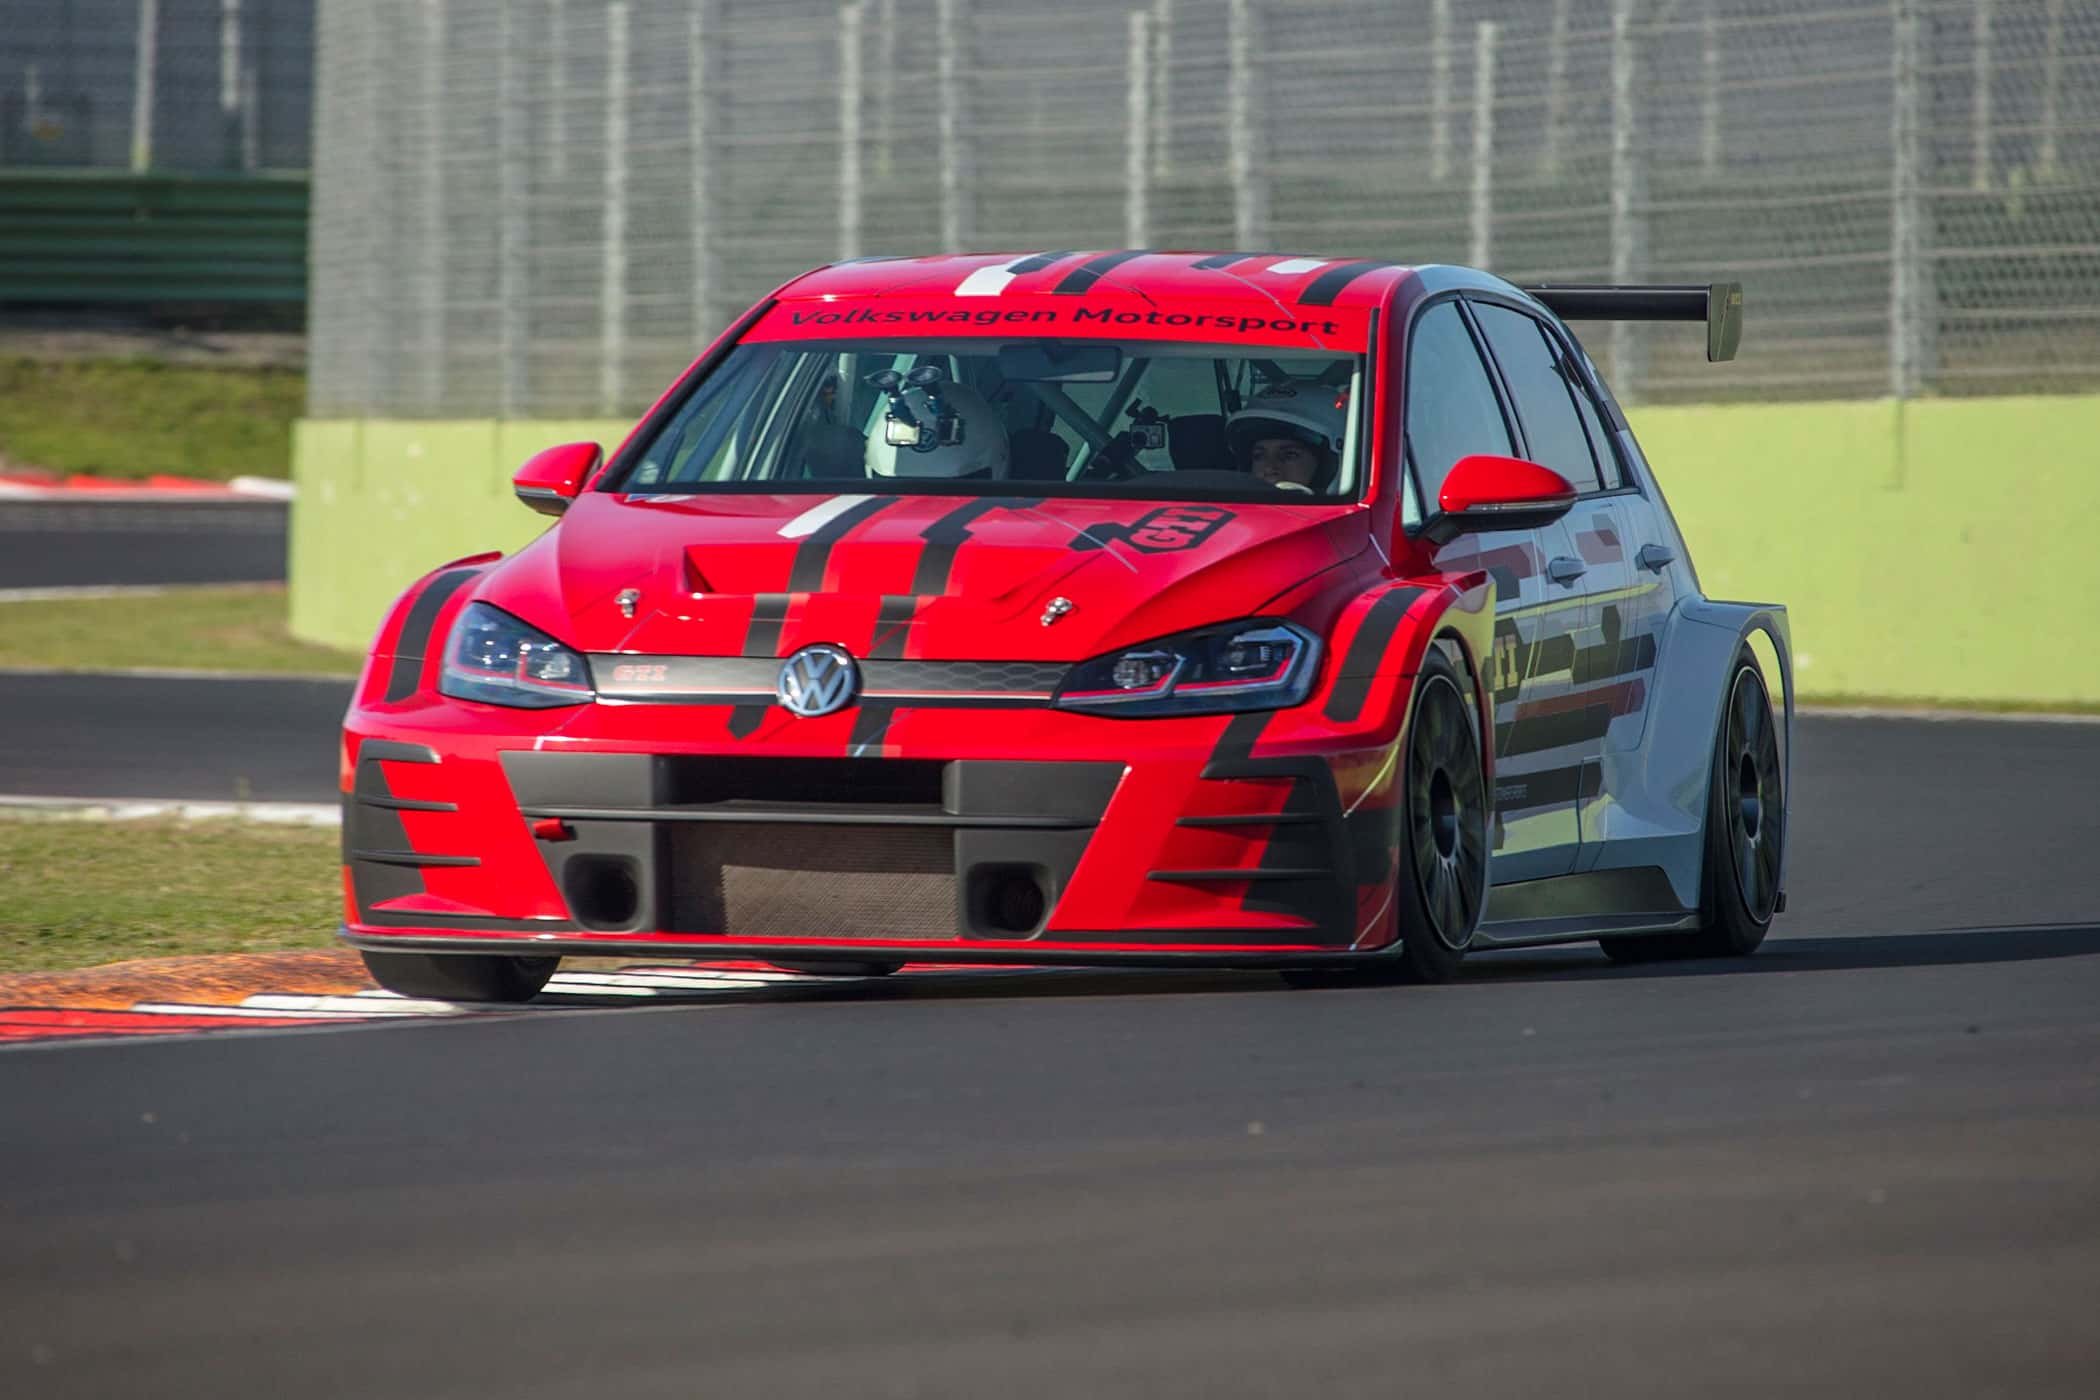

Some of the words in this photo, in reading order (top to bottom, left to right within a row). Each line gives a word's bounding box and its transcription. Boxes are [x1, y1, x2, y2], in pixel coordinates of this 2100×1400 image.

[792, 308, 1057, 326] Volkswagen
[1073, 307, 1341, 335] Motorsport
[1129, 507, 1225, 549] GTI
[613, 664, 668, 682] GTI
[783, 646, 854, 716] VW
